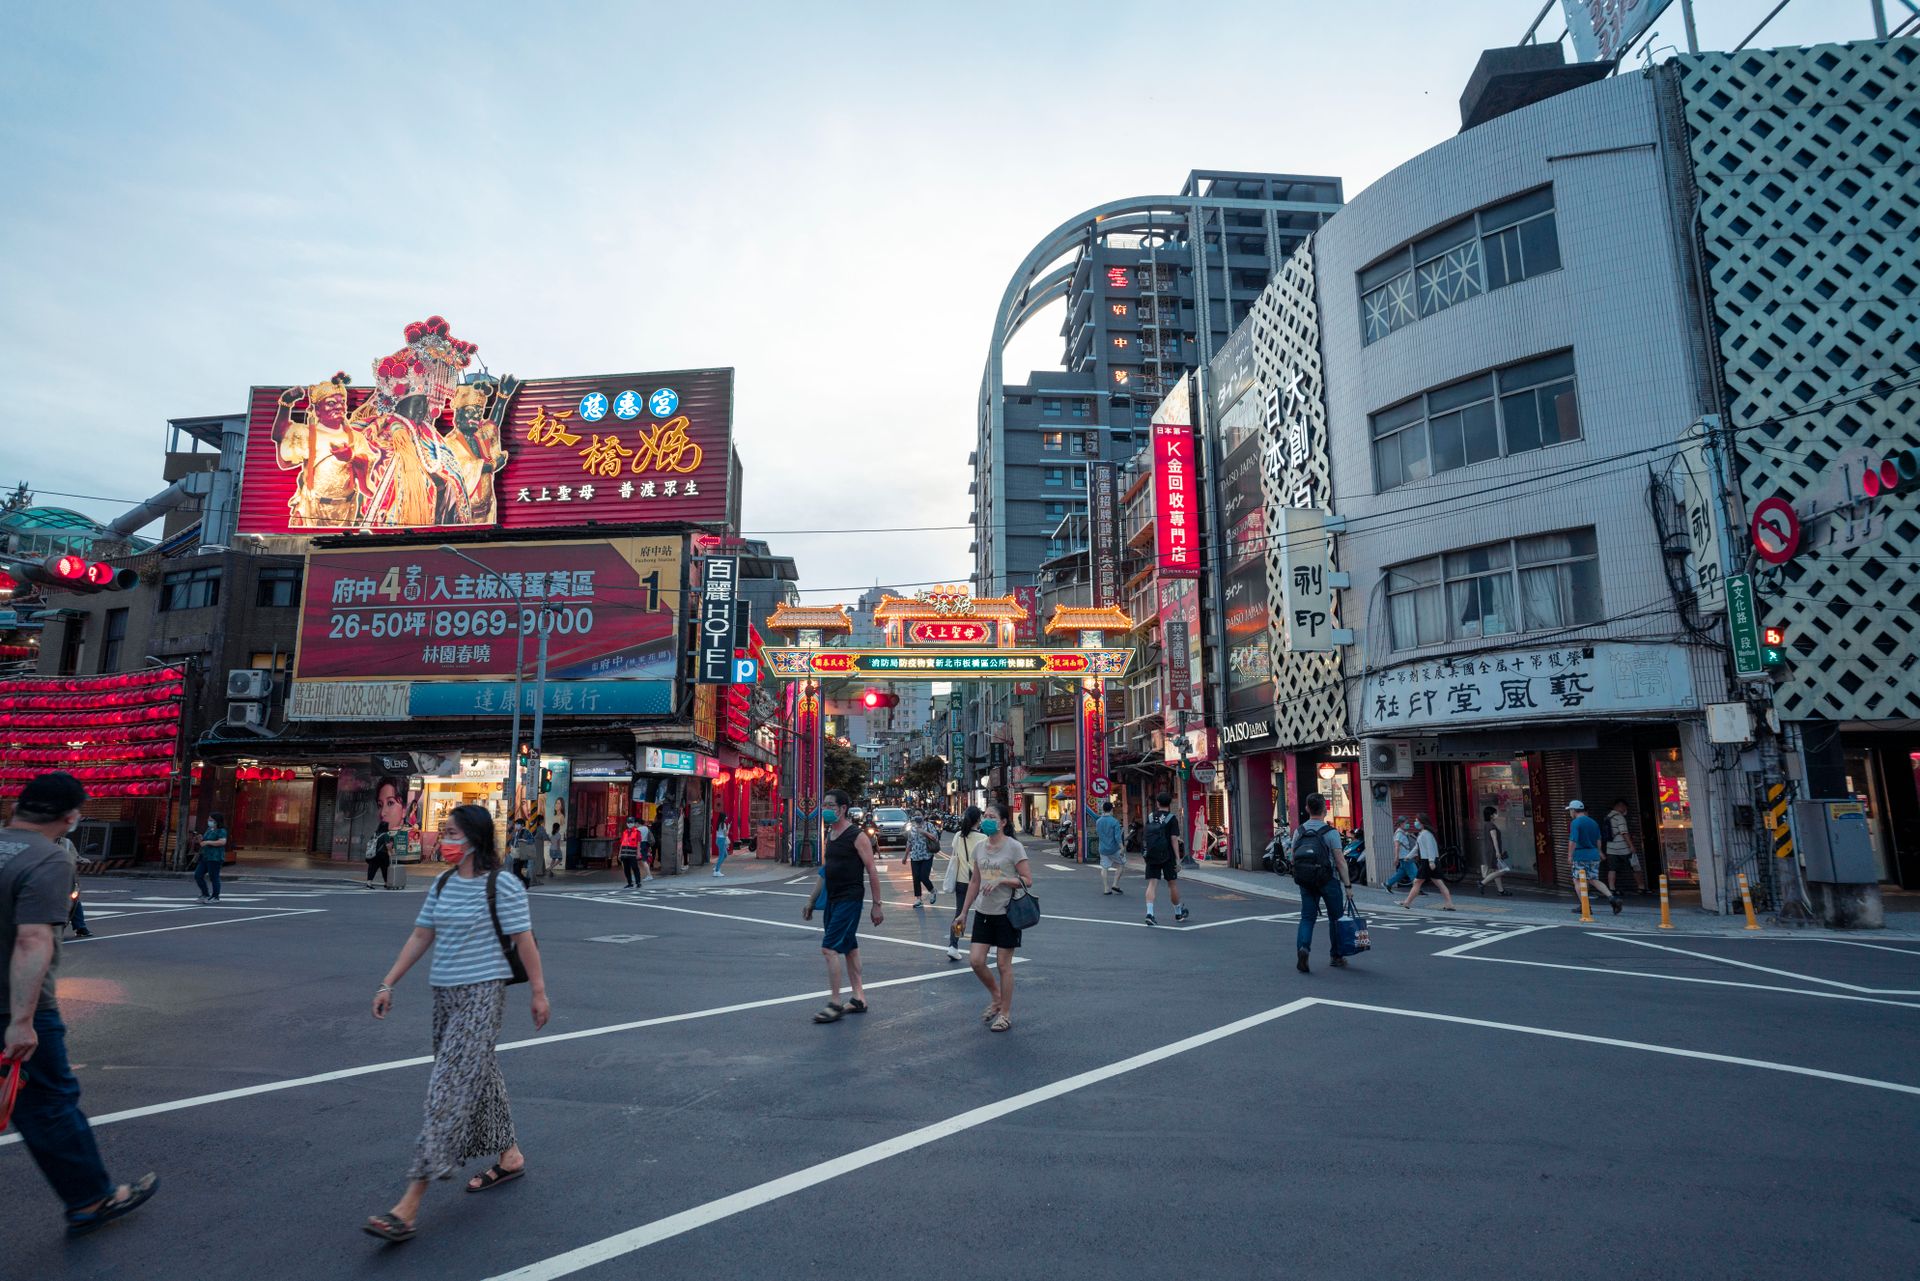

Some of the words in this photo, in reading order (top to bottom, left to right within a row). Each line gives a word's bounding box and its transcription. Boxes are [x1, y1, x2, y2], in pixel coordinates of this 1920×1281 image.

[1157, 427, 1189, 435] 日本第一
[1266, 387, 1285, 479] 日本
[517, 486, 595, 502] 天上聖母
[618, 480, 699, 499] 普渡眾生
[1167, 441, 1186, 563] K金回收專門店
[431, 570, 595, 600] 入主板橋蛋黃區
[642, 570, 658, 611] 1
[329, 612, 425, 638] 26-50坪
[435, 608, 593, 636] 8969-9000
[925, 626, 975, 639] 天上聖母
[1733, 588, 1751, 649] 文化路一段
[423, 644, 491, 663] 林園春曉
[702, 604, 729, 679] HOTEL
[475, 685, 601, 712] 達康眼鏡行
[1224, 721, 1250, 743] DAISO
[1249, 721, 1268, 736] JAPAN
